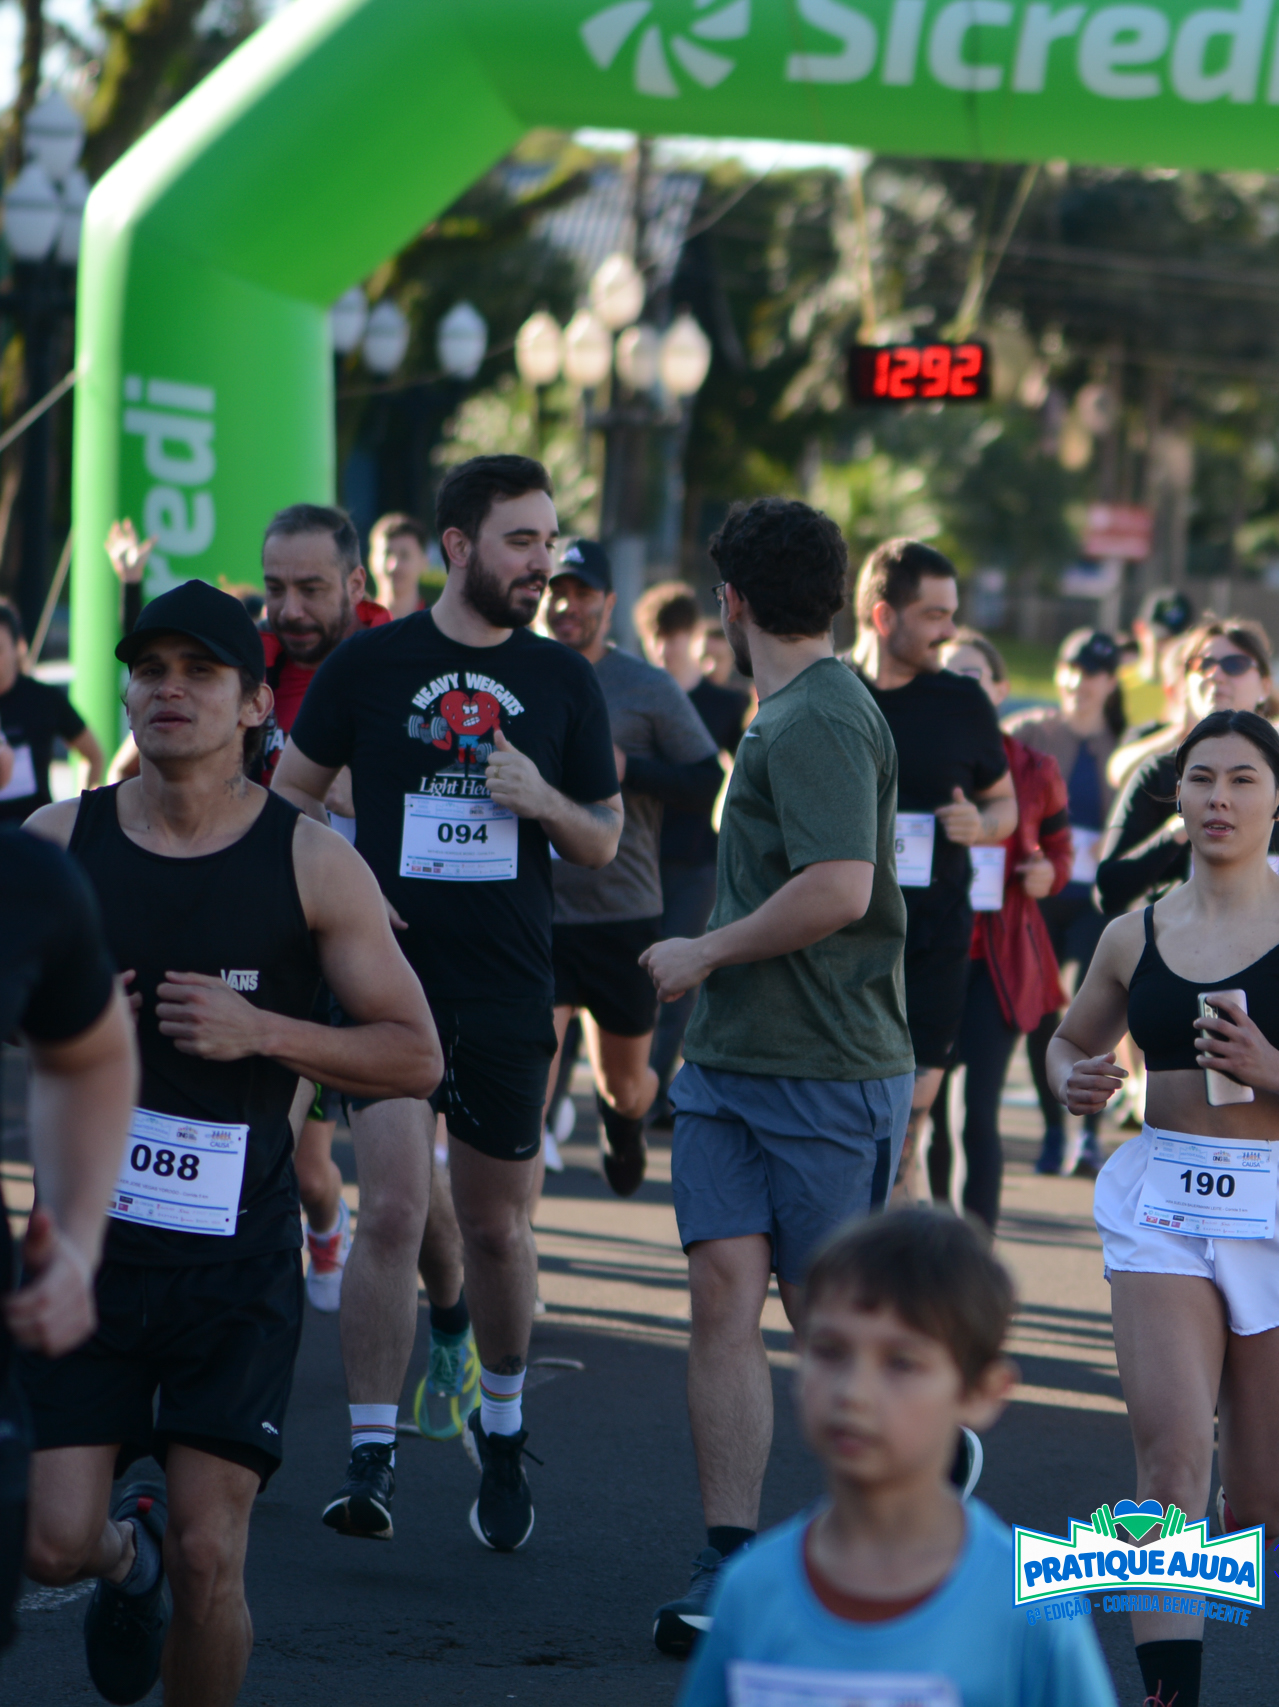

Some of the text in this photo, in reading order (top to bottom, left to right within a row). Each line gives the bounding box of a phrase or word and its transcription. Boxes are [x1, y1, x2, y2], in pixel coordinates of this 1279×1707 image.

[411, 672, 525, 716] HEAVY WEIGHTS
[419, 776, 459, 797] Light
[438, 822, 488, 844] 094
[220, 968, 259, 991] VANS
[130, 1143, 200, 1181] 088
[1180, 1169, 1235, 1198] 190
